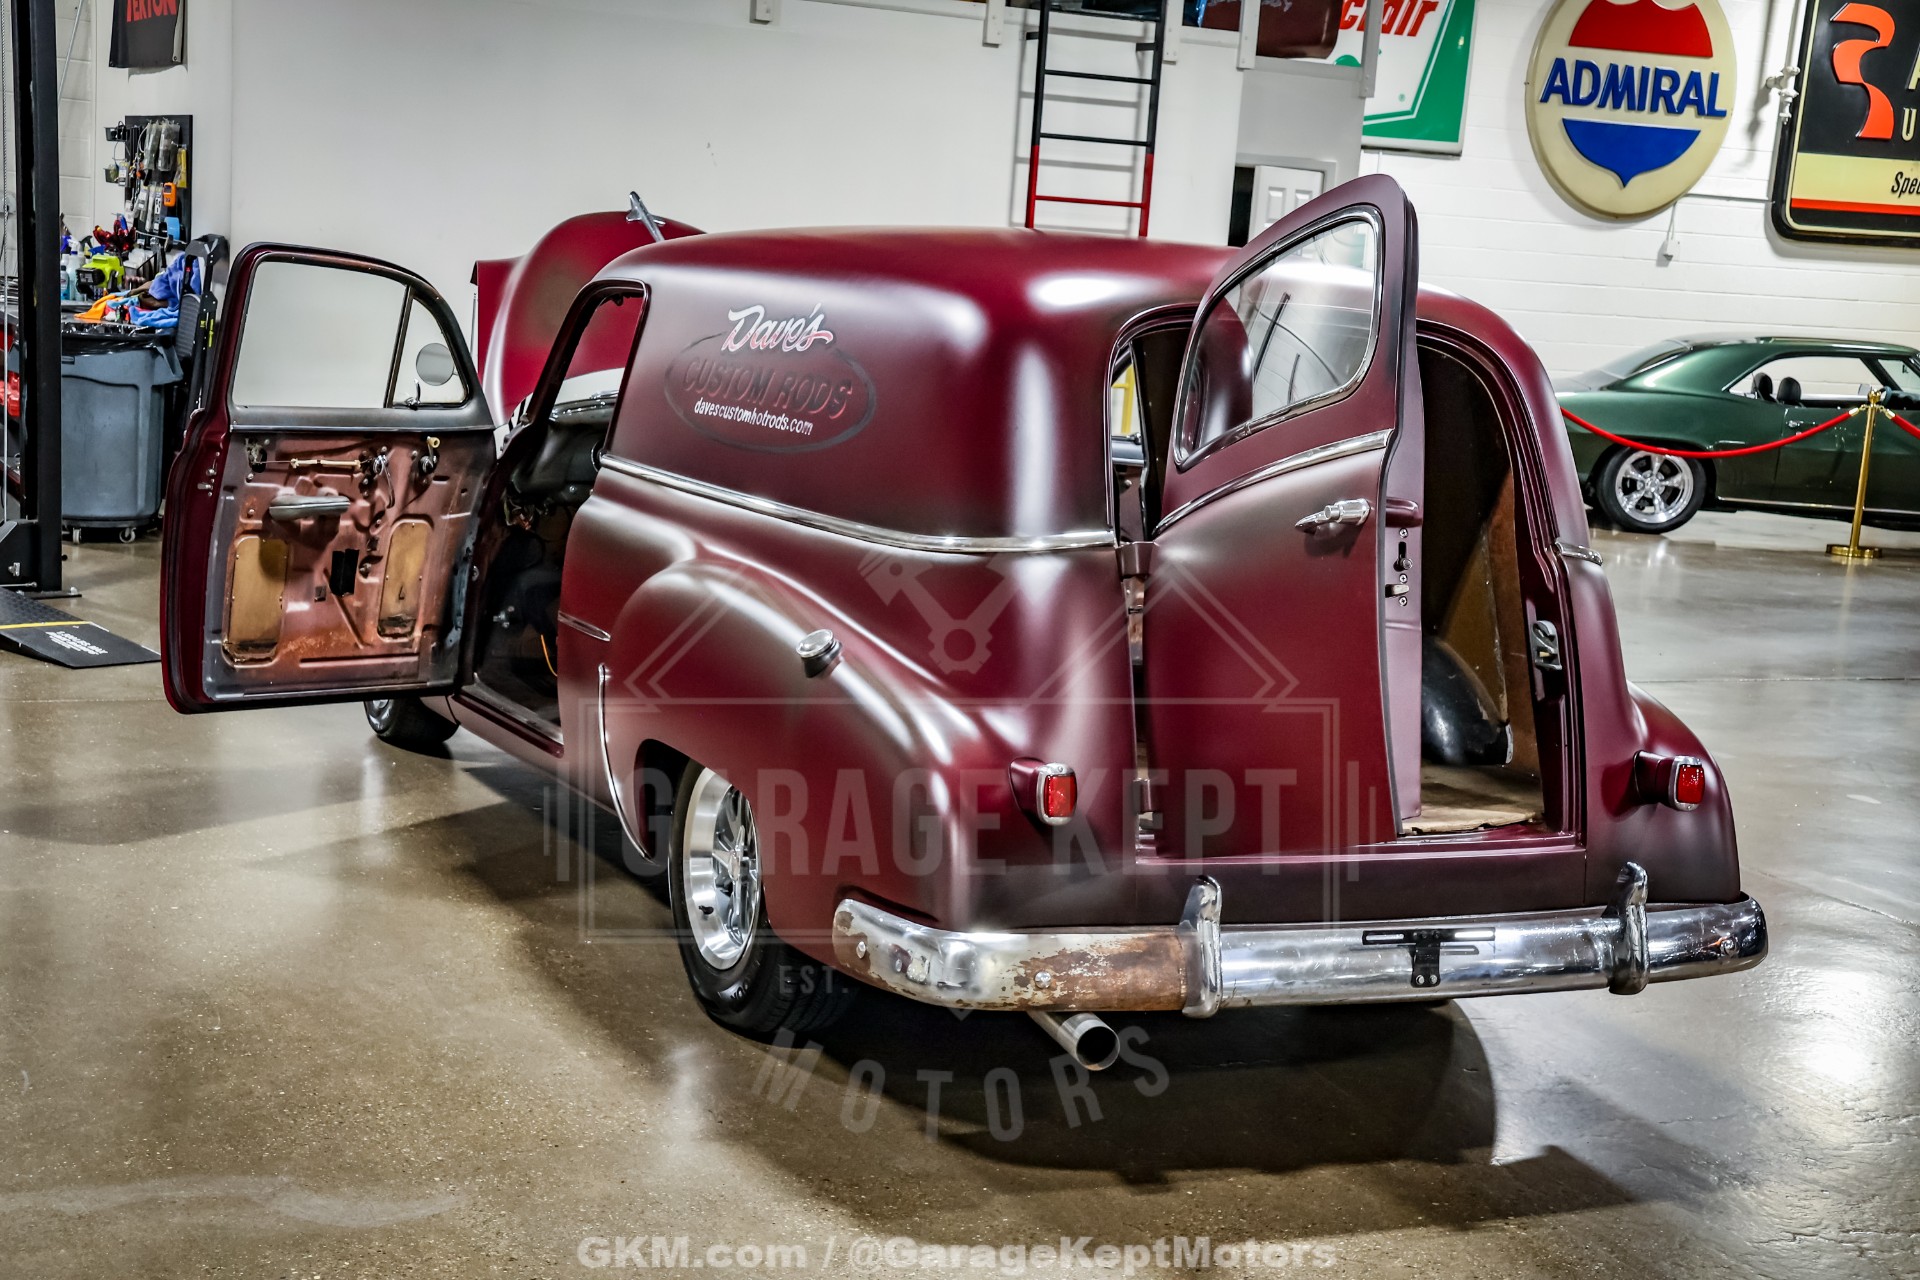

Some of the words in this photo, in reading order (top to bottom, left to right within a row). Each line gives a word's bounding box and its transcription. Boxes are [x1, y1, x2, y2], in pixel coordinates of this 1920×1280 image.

[1539, 57, 1727, 118] ADMIRAL
[721, 303, 833, 352] Dave's
[683, 357, 776, 408] CUSTOM
[774, 370, 853, 420] RODS
[694, 397, 814, 436] davescustomhotrods.com
